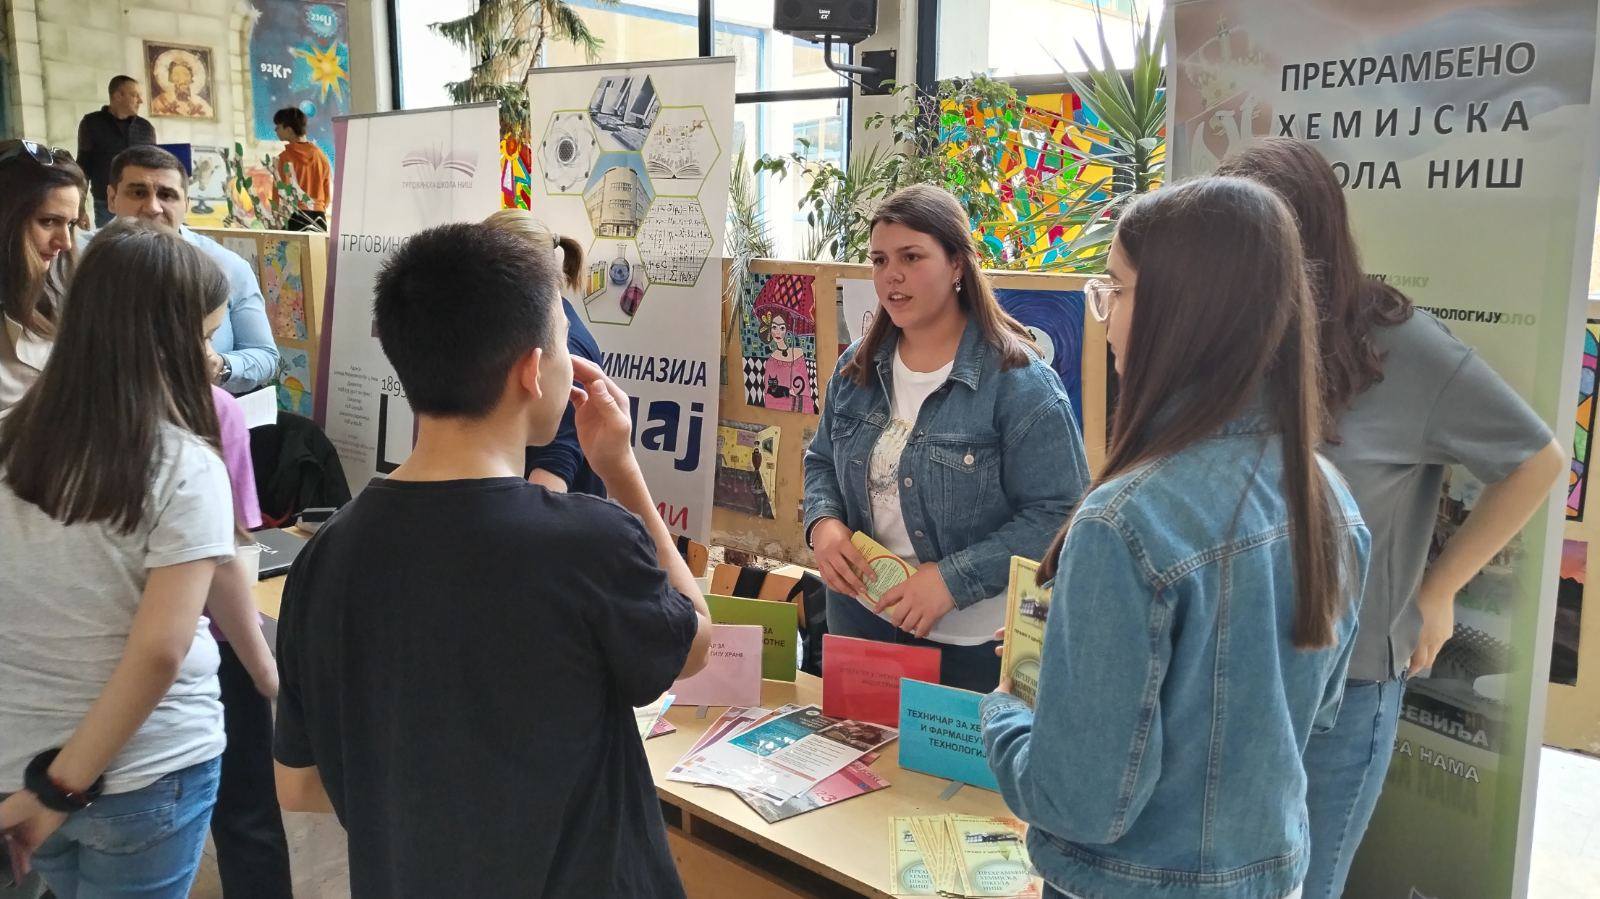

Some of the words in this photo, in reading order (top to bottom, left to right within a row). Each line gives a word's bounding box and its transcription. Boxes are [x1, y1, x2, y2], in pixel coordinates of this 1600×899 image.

[260, 63, 292, 79] 92Kr
[1281, 42, 1536, 92] ПРЕХРАМБЕНО
[1278, 100, 1529, 140] ХЕМИЈСКА
[1427, 158, 1524, 189] НИШ
[906, 708, 954, 726] ТЕХНИЧАР
[956, 719, 968, 730] ЗА
[920, 724, 927, 732] И
[1419, 746, 1481, 784] НАМА
